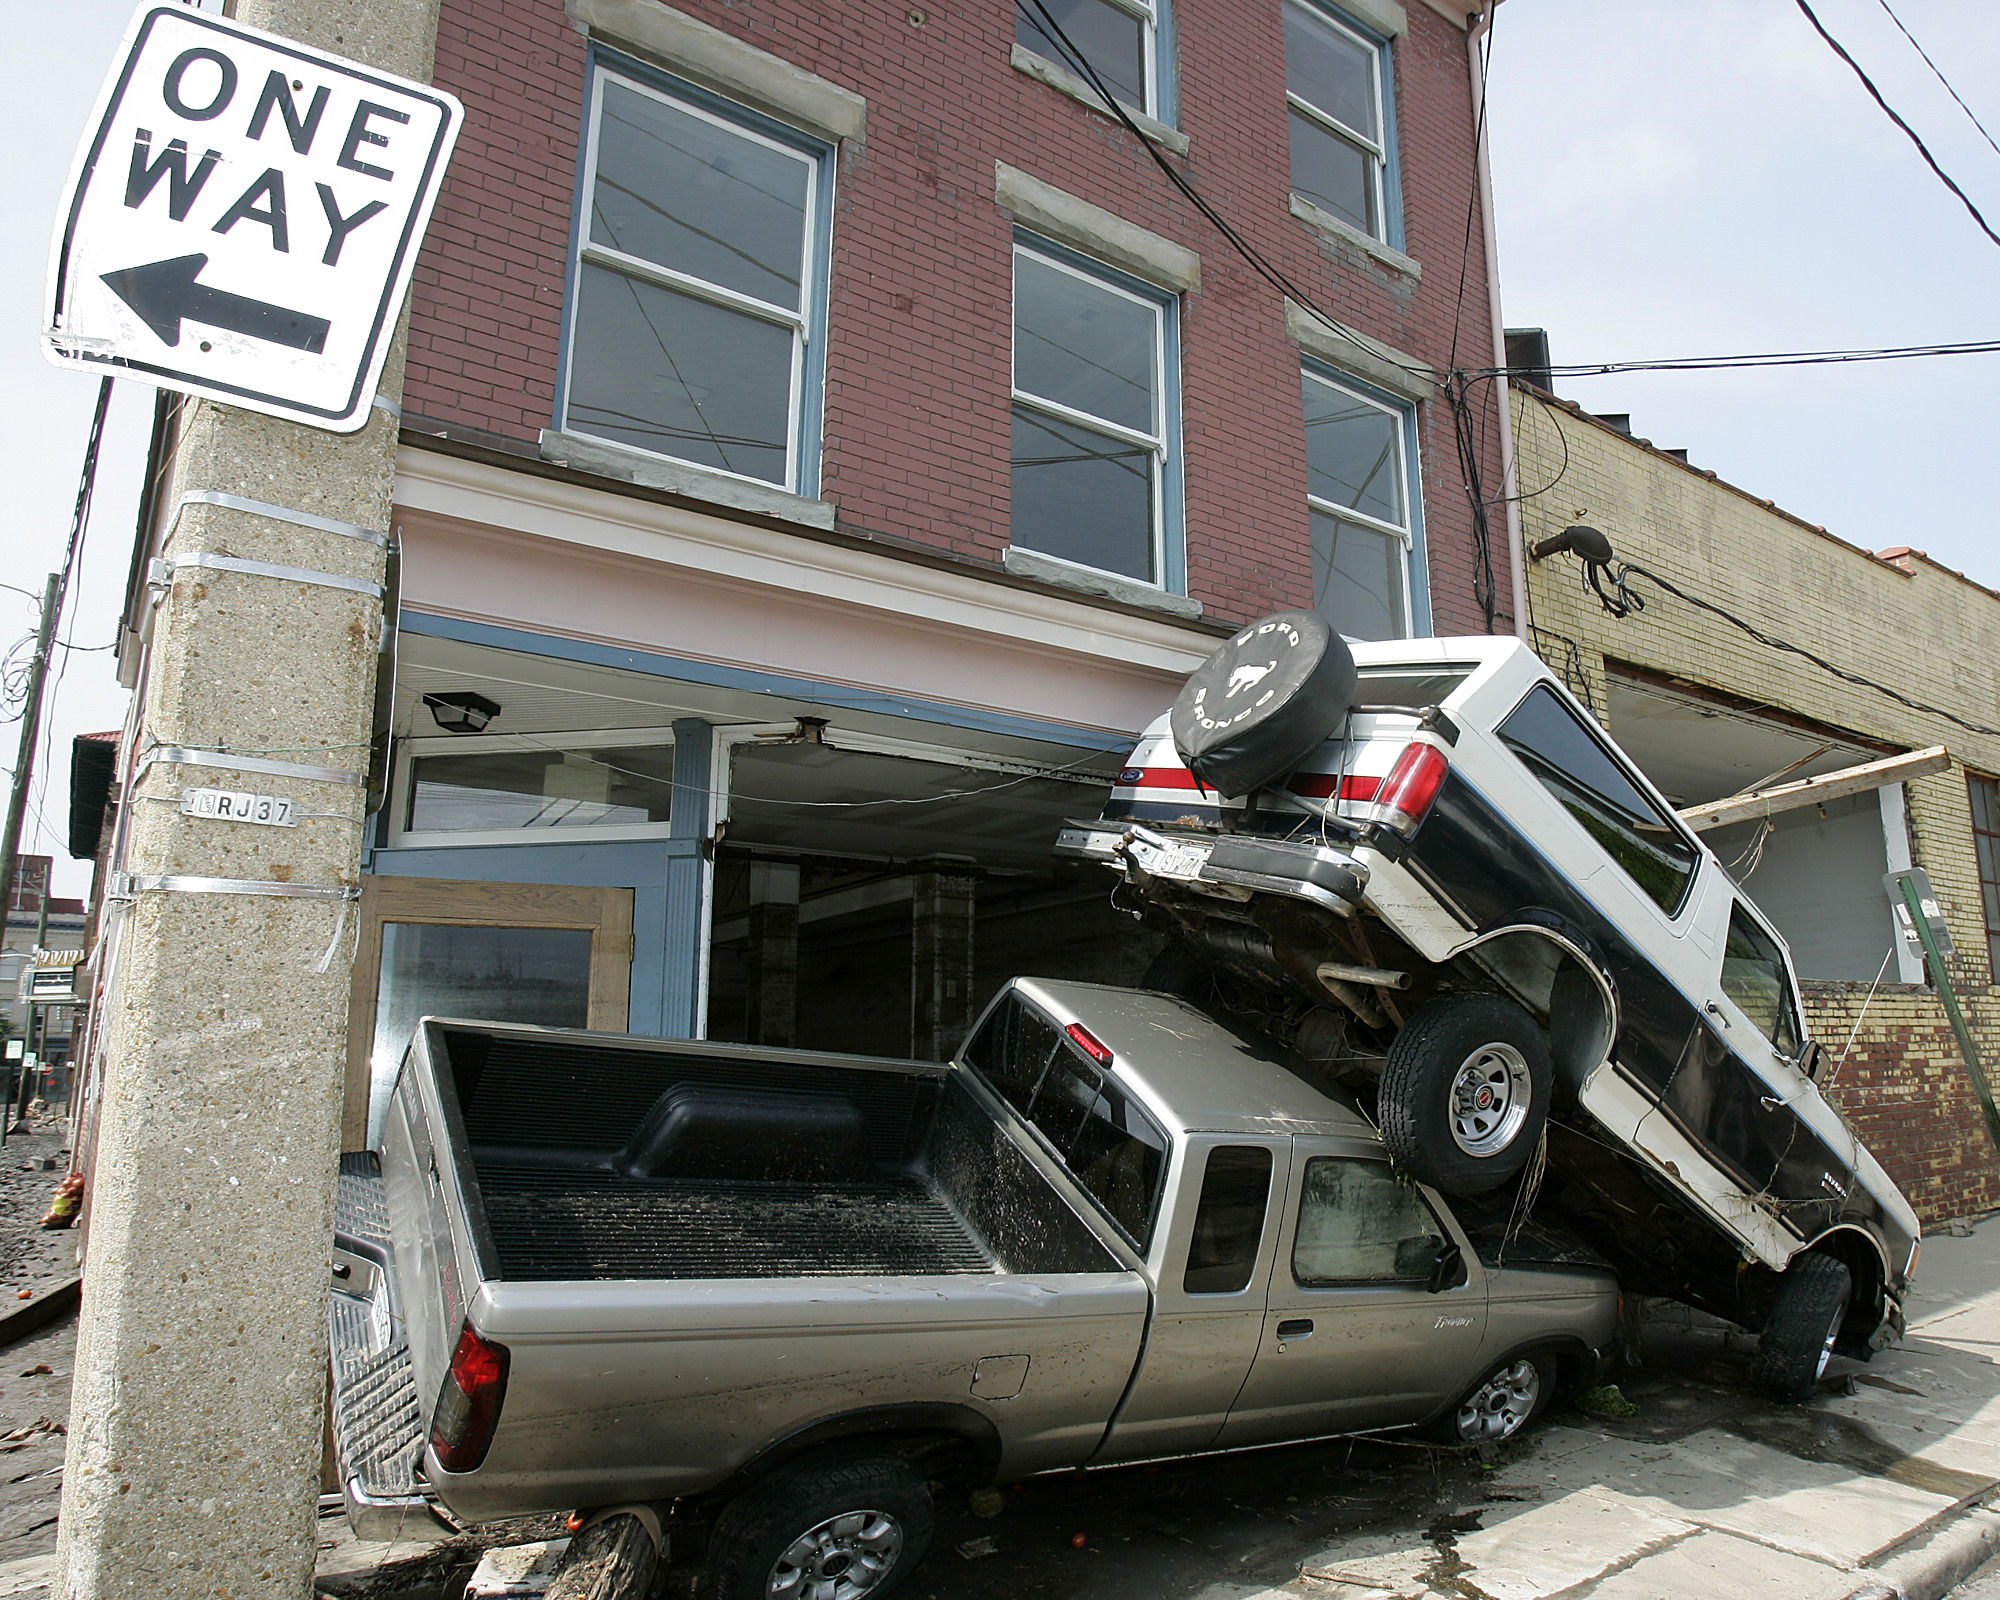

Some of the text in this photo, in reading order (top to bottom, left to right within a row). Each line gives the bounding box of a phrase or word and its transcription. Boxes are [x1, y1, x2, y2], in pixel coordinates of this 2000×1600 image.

[163, 47, 411, 182] ONE
[124, 127, 390, 267] WAY
[1237, 622, 1299, 647] FORD
[217, 796, 289, 822] RJ37
